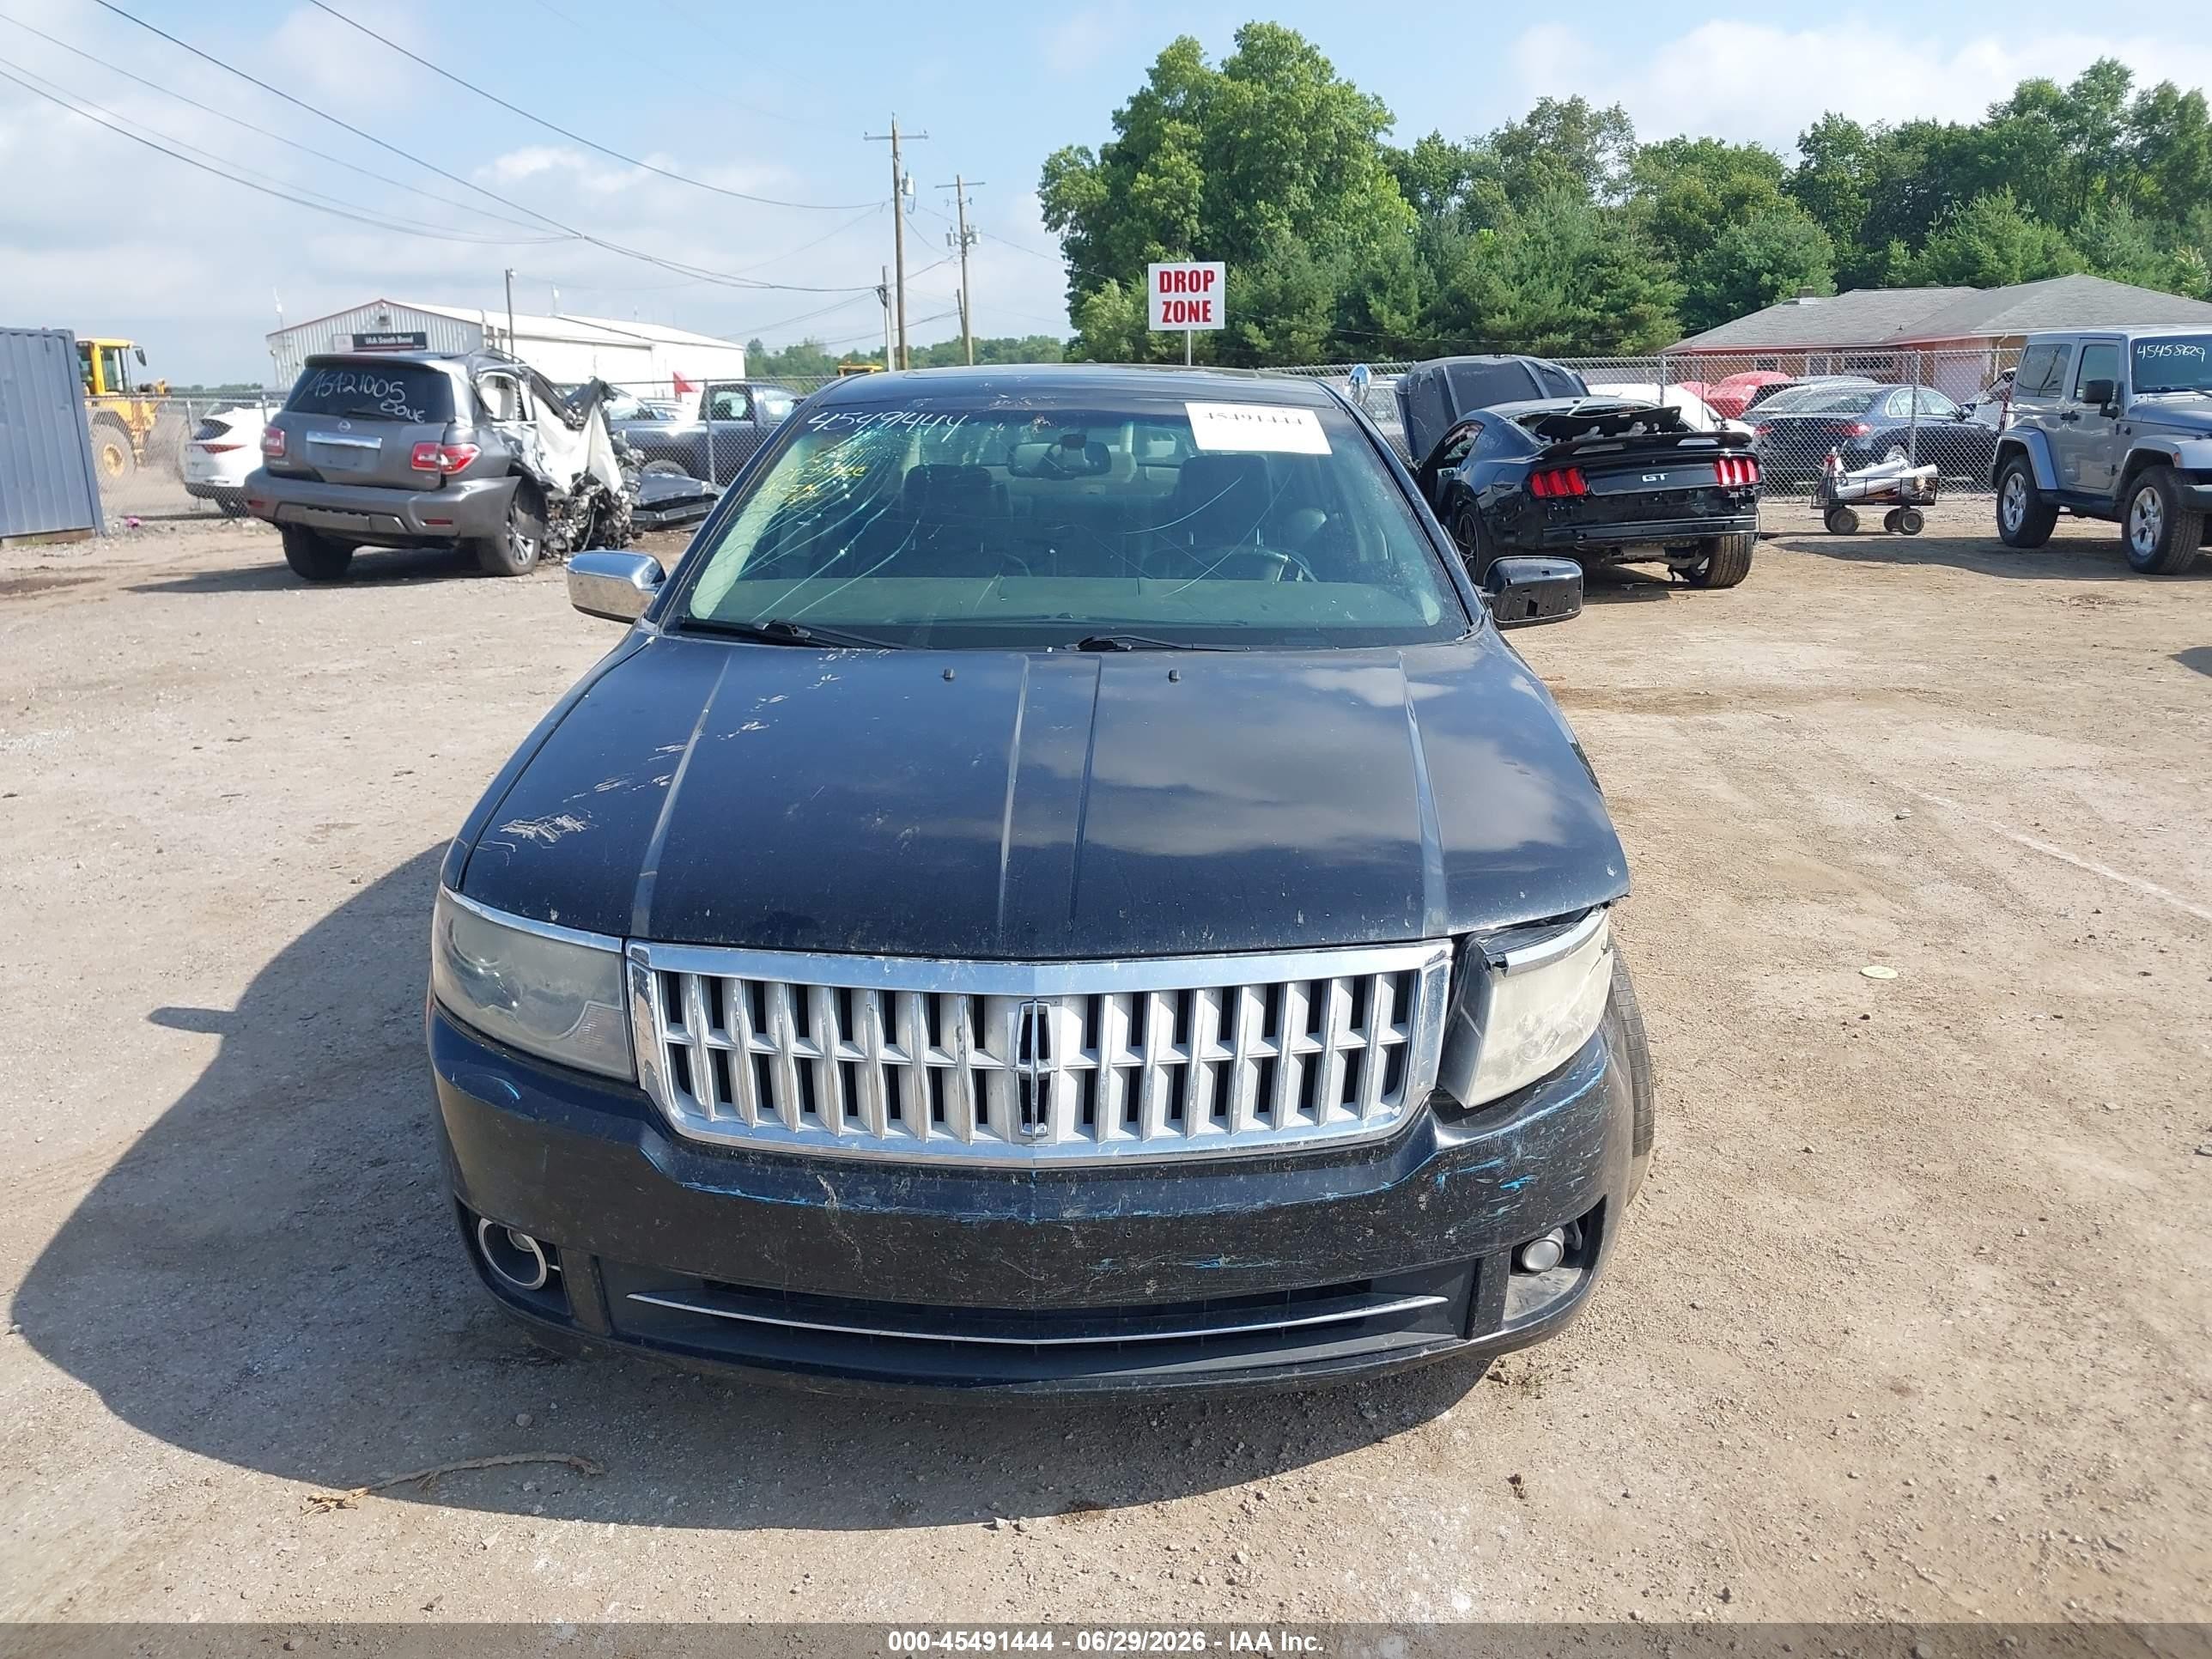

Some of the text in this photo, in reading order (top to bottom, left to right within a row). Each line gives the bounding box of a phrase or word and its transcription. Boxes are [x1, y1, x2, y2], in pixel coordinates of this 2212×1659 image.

[1159, 270, 1215, 293] DROP
[1162, 300, 1212, 324] ZONE
[2136, 344, 2206, 362] 45458629
[807, 411, 969, 442] 45491444
[1642, 472, 1670, 483] GT
